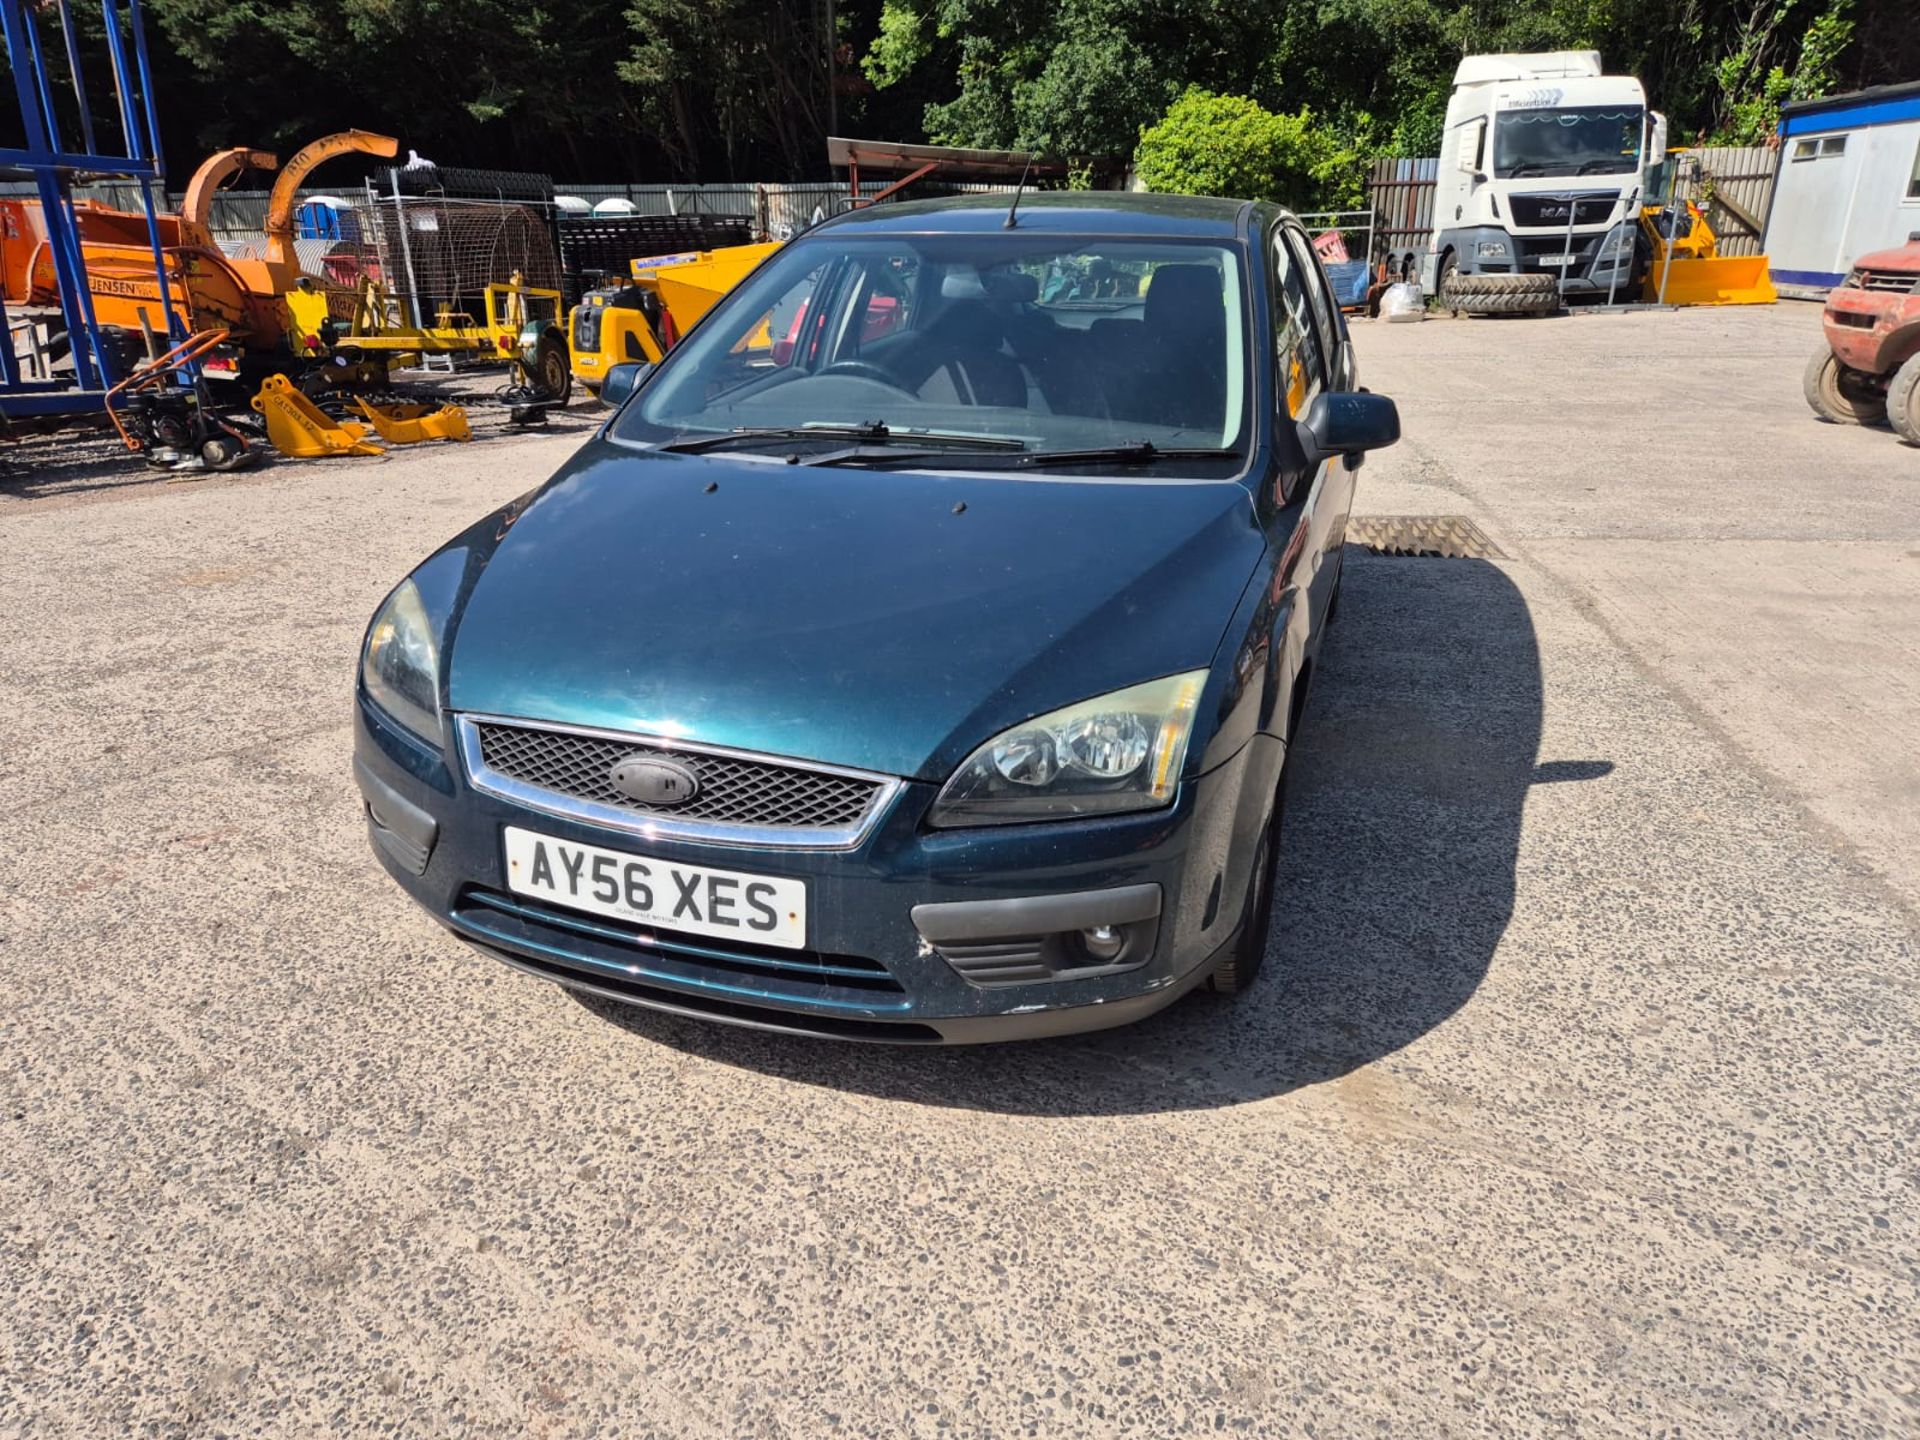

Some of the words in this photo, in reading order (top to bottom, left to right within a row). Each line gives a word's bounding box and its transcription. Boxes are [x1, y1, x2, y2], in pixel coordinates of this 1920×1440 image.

[1539, 206, 1587, 218] MAN
[90, 277, 135, 294] JENSEN
[531, 841, 654, 912] AY56
[671, 869, 778, 931] XES
